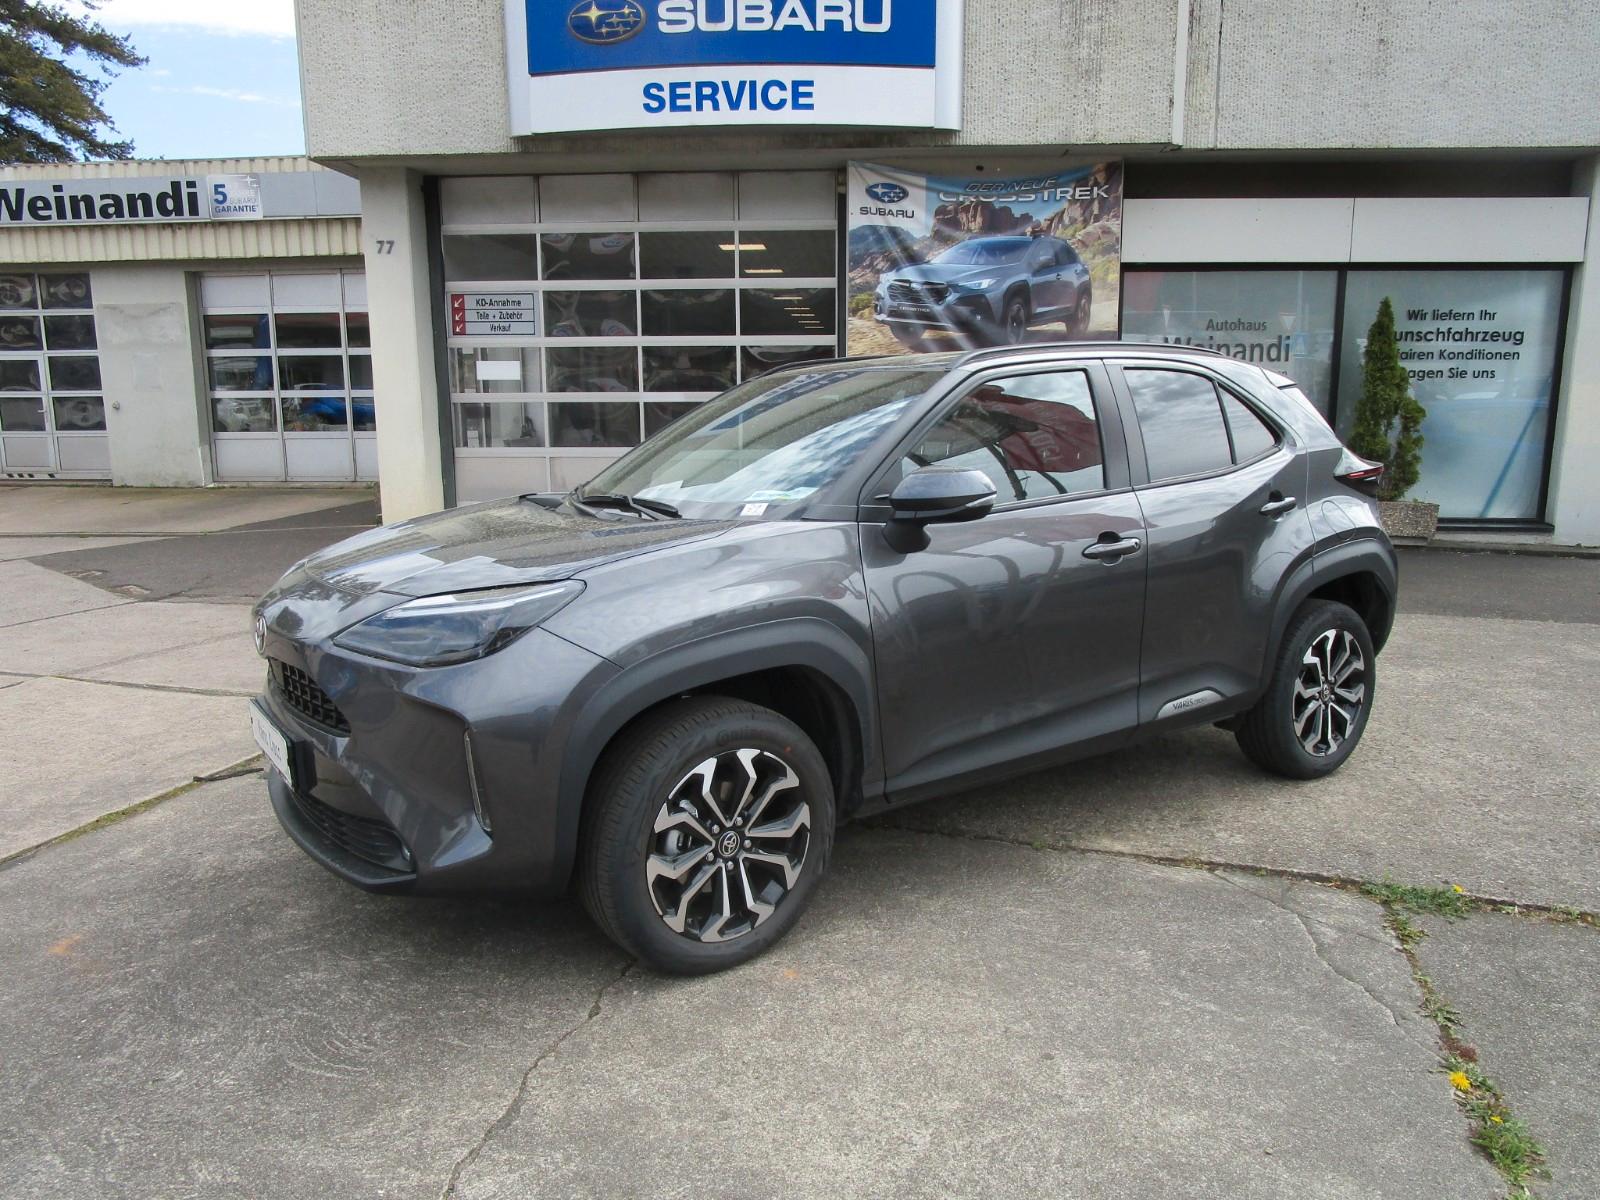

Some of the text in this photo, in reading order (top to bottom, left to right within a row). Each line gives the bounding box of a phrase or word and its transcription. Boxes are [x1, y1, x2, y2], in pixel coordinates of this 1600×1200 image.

[657, 0, 892, 34] SUBARU
[642, 79, 815, 114] SERVICE
[213, 183, 228, 206] 5
[214, 205, 257, 213] GARANTIE
[859, 206, 915, 219] SUBARU
[375, 239, 395, 255] 77
[475, 298, 522, 307] KD-Annahme
[498, 311, 523, 320] Zubehör
[1407, 309, 1497, 320] Wir liefern Ihr
[489, 323, 512, 333] Verkauf
[1206, 318, 1267, 331] Autohaus
[1394, 327, 1525, 346] unschfahrzeug
[1439, 349, 1520, 360] Konditionen
[1408, 367, 1496, 381] agen Sie uns
